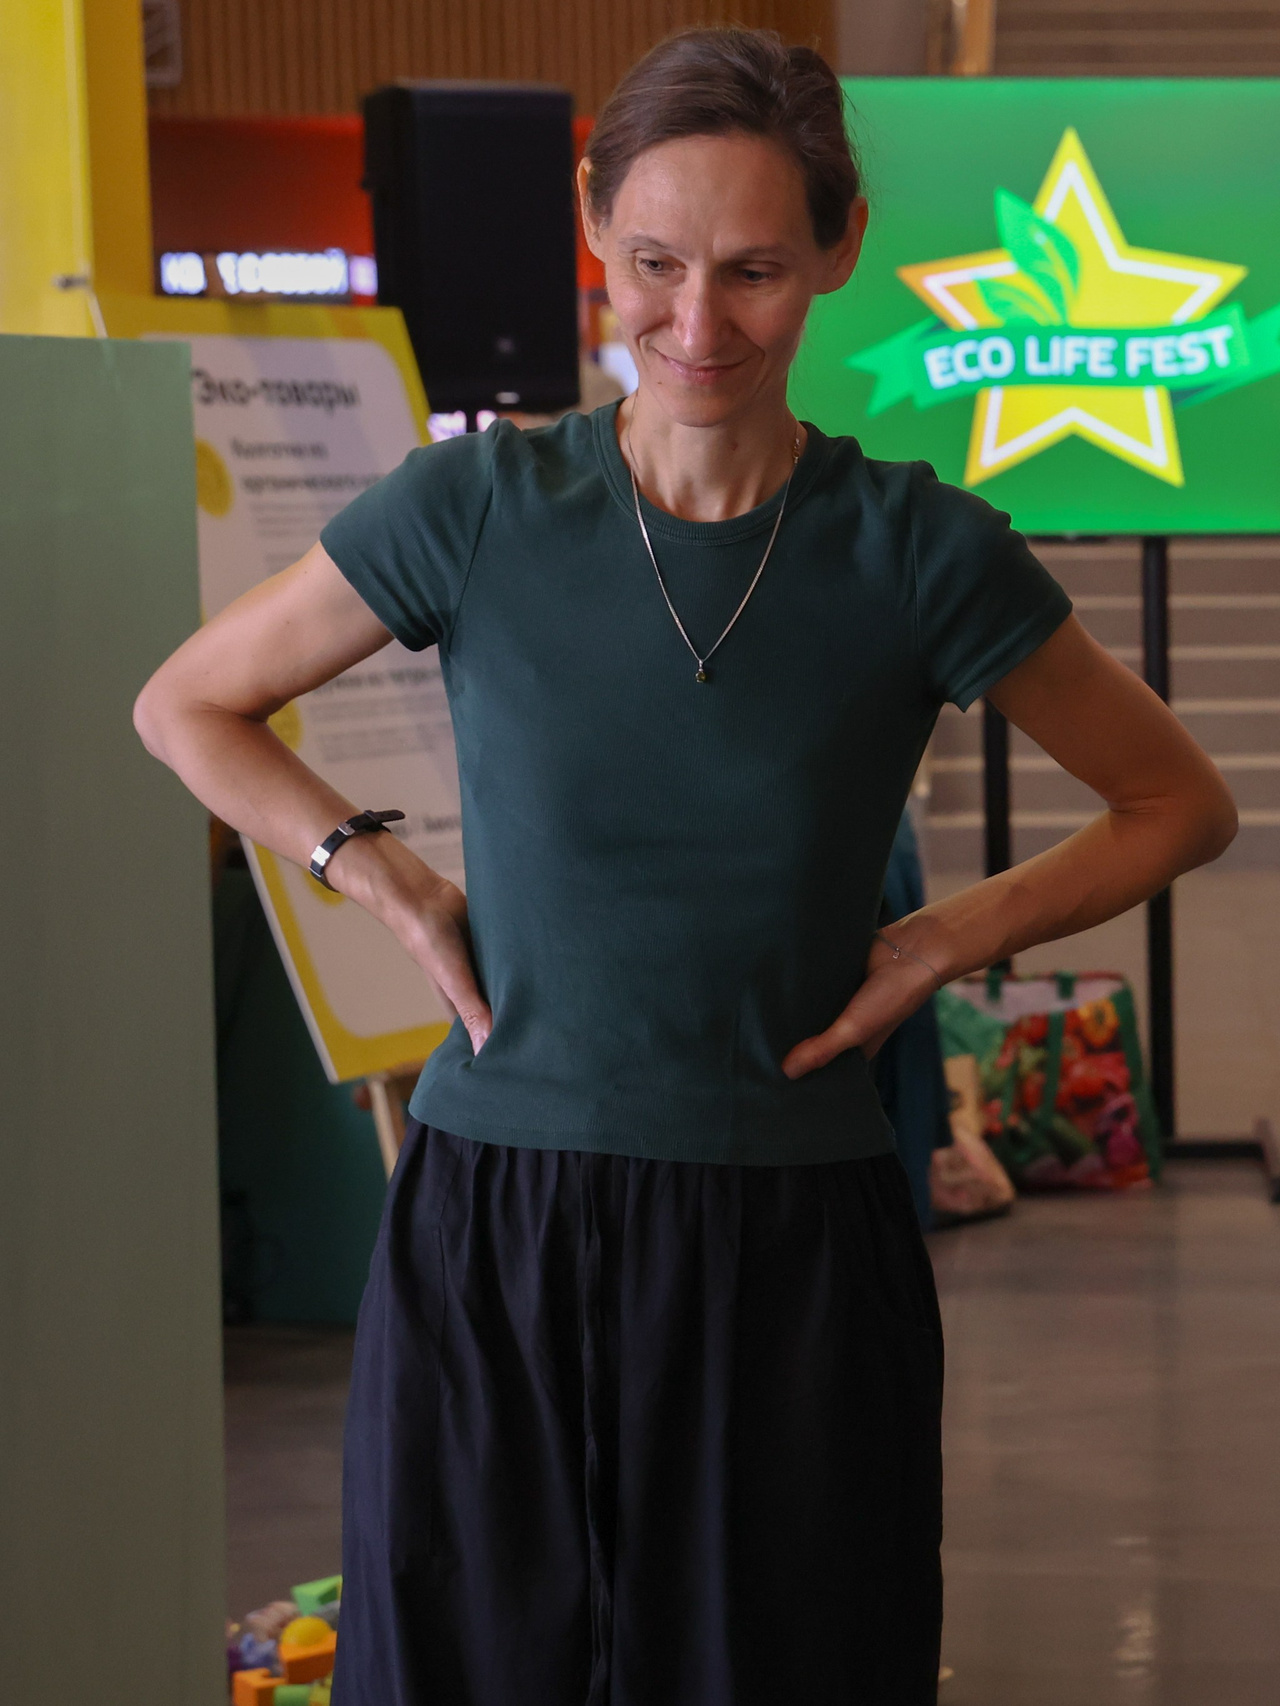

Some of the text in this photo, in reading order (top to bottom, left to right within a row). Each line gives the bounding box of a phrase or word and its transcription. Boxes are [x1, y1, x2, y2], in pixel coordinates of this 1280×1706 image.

[924, 324, 1234, 390] ECO LIFE FEST
[191, 366, 361, 416] Эко-товары
